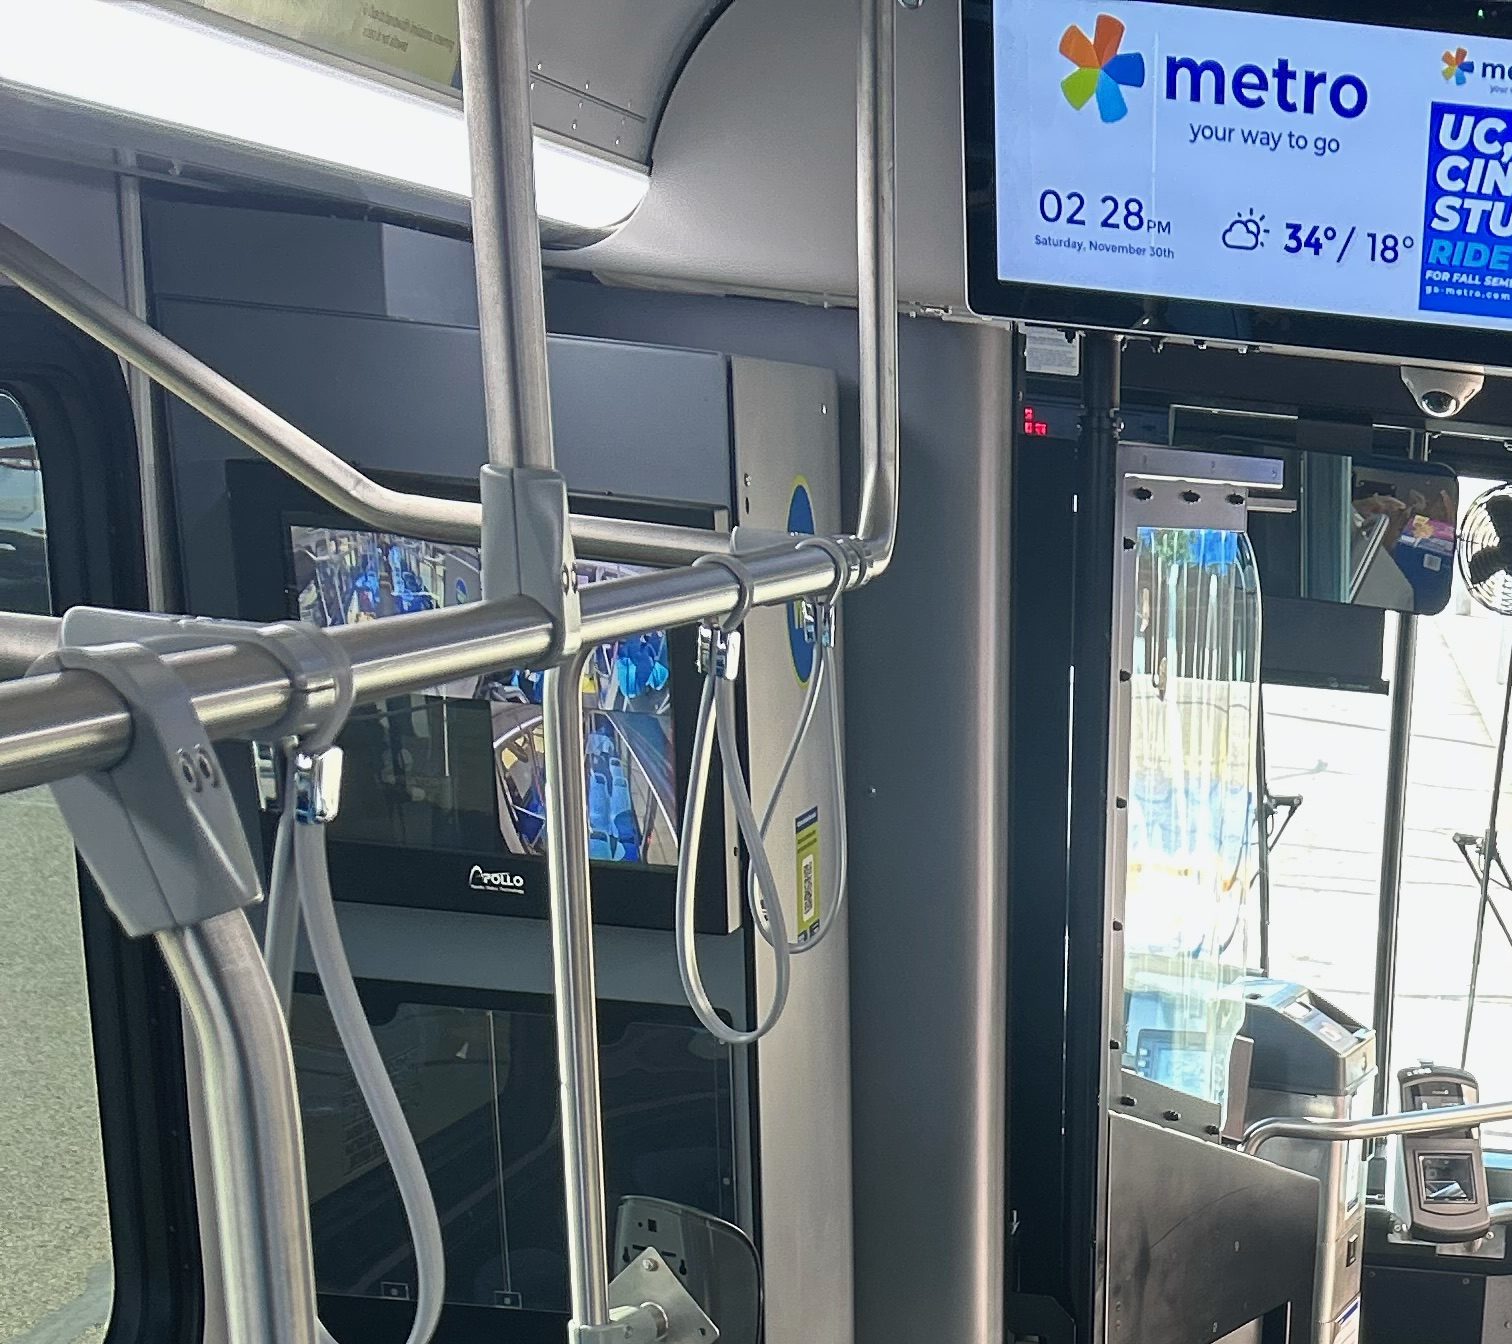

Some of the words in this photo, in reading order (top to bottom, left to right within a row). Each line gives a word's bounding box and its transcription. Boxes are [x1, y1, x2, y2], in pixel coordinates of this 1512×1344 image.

[1165, 55, 1368, 119] metro
[1189, 122, 1235, 143] your
[1241, 128, 1282, 152] way
[1289, 130, 1308, 150] to
[1313, 136, 1340, 157] go
[1039, 189, 1086, 226] 02
[1035, 234, 1088, 252] Saturday,
[1089, 240, 1146, 257] November
[1149, 245, 1175, 260] 30th
[1425, 270, 1450, 283] FOR
[1452, 272, 1482, 286] FALL
